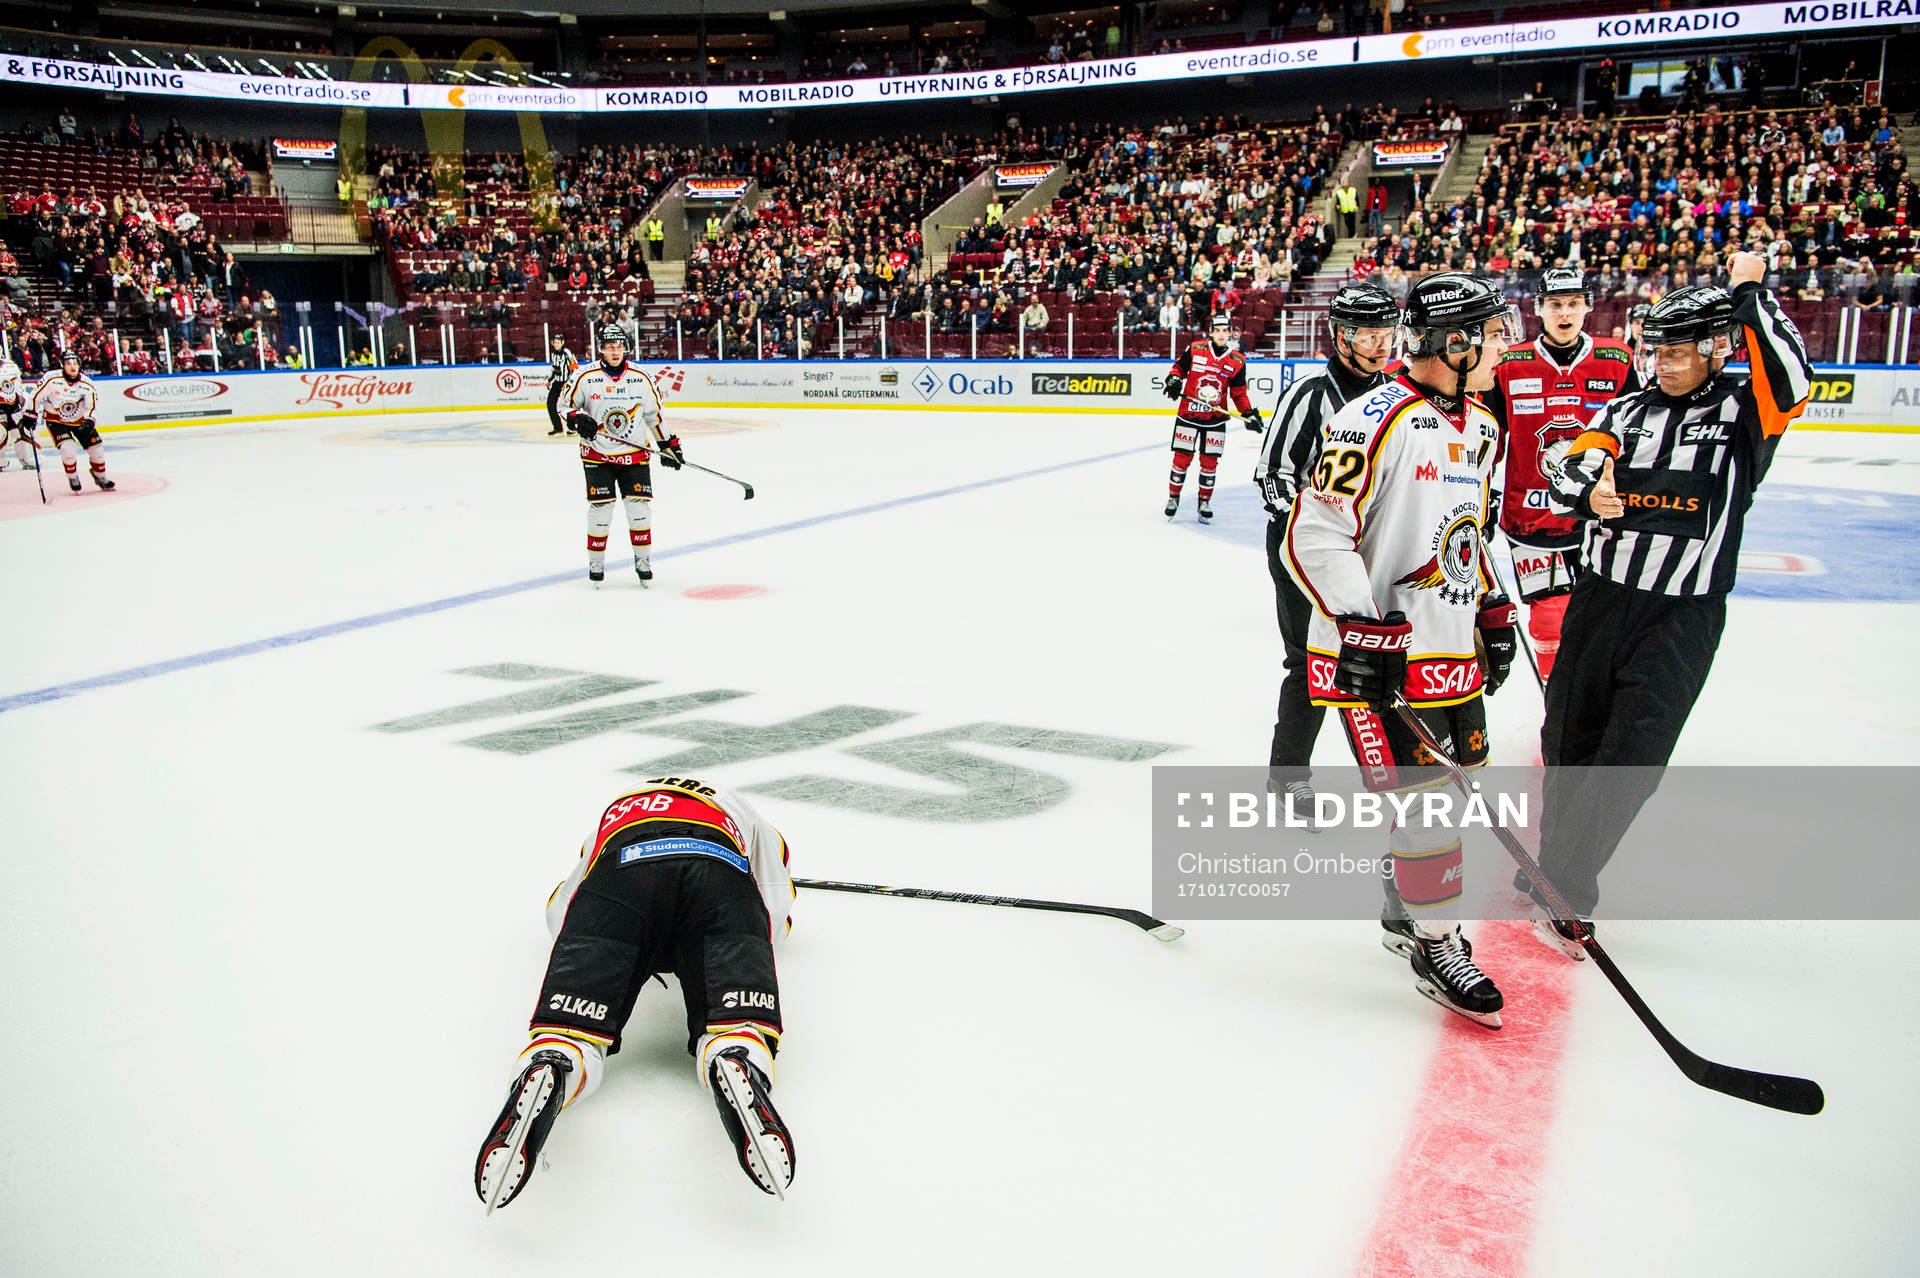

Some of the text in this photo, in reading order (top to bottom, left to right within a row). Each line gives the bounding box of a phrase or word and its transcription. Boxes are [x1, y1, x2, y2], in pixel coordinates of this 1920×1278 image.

[1598, 11, 1740, 37] KOMRADIO
[1425, 28, 1556, 53] pm eventradio
[1187, 48, 1319, 71] eventradio.se
[8, 59, 184, 88] & FÖRSÄLJNING
[879, 62, 1137, 95] UTHYRNING & FÖRSÄLJNING
[240, 82, 371, 101] eventradio.se
[498, 93, 576, 105] eventradio
[606, 91, 709, 105] KOMRADIO
[739, 84, 854, 103] MOBILRADIO
[803, 371, 834, 383] Singel?
[948, 373, 1014, 396] Ocab
[1034, 375, 1128, 394] Tedadmin
[1588, 380, 1614, 391] RSA
[138, 384, 215, 397] HAGA GRUPPEN
[296, 374, 414, 409] Landgren
[803, 387, 900, 399] NORDANÅ GRUSTERMINAL
[1362, 386, 1409, 424] SSAB
[1333, 429, 1366, 446] LKAB
[1683, 424, 1731, 441] SHL
[1318, 448, 1366, 497] 52
[1421, 662, 1479, 695] SSAB
[601, 793, 675, 831] SSAB
[562, 994, 608, 1021] LKAB
[740, 991, 775, 1010] LKAB
